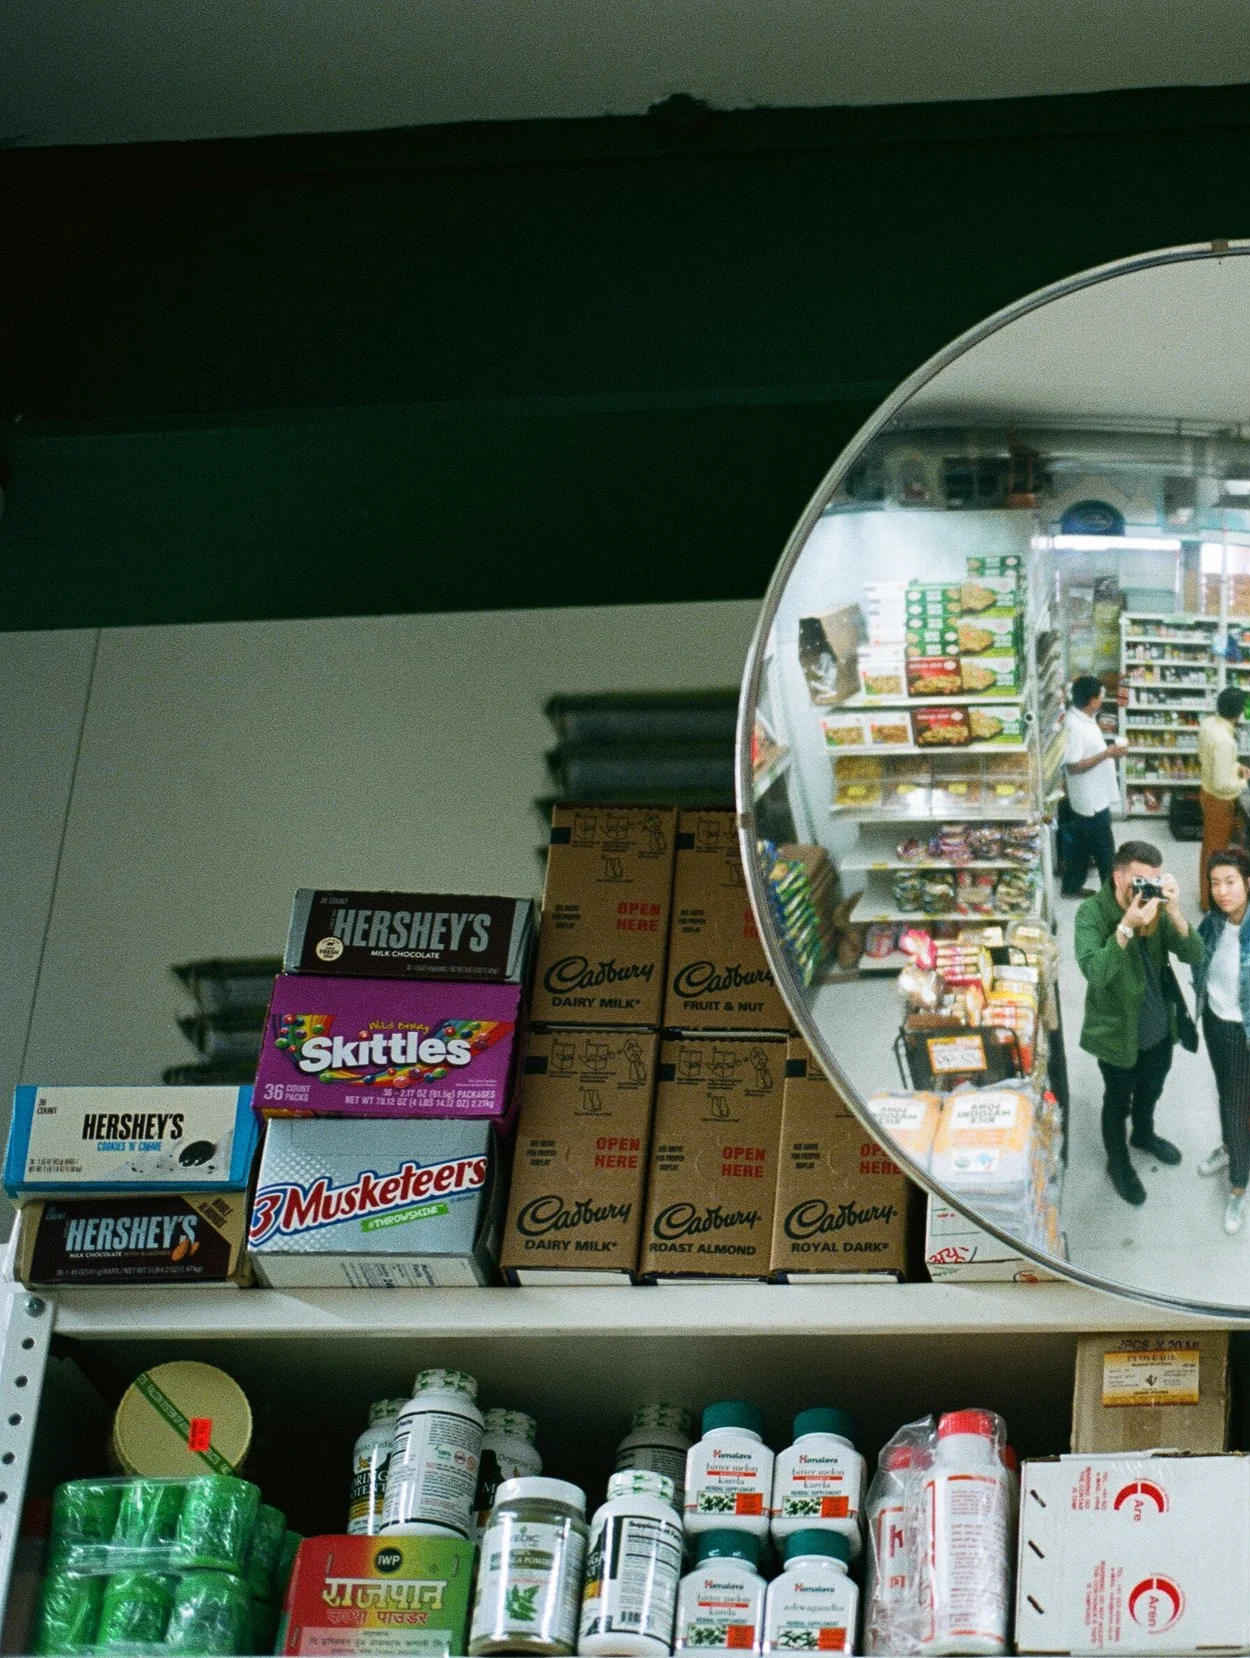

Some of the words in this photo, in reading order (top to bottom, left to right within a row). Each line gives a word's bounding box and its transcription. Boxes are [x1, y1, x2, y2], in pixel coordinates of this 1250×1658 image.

[616, 901, 661, 916] OPEN
[333, 909, 491, 952] HERSHEY'S
[616, 918, 658, 932] HERE
[392, 951, 440, 959] CHOCOLATE
[544, 955, 654, 995] Cadbury
[674, 961, 776, 998] Cadbury
[553, 997, 595, 1007] DAIRY
[684, 1001, 721, 1011] FRUIT
[724, 1001, 734, 1012] &
[738, 1002, 765, 1012] NUT
[299, 1031, 472, 1073] Skittles
[263, 1084, 284, 1100] 36
[286, 1085, 311, 1093] COUNT
[285, 1093, 309, 1101] PACKS
[457, 1091, 496, 1099] PACKAGES
[82, 1114, 185, 1140] HERSHEY'S
[596, 1137, 640, 1151] OPEN
[859, 1144, 887, 1157] OP
[721, 1146, 766, 1161] OPEN
[594, 1155, 638, 1168] HERE
[859, 1160, 902, 1175] HERE
[721, 1164, 763, 1178] HERE
[249, 1194, 282, 1238] 3
[282, 1158, 487, 1230] Musketeers
[517, 1195, 632, 1236] Cadbury
[653, 1202, 759, 1240] Cadbury
[784, 1199, 893, 1240] Cadbury
[65, 1215, 199, 1251] HERSHEY'S
[525, 1239, 571, 1250] DAIRY
[650, 1242, 693, 1253] ROAST
[697, 1244, 756, 1256] ALMOND
[791, 1242, 838, 1253] ROYAL
[1134, 1500, 1144, 1521] Are
[377, 1555, 400, 1566] IWP
[321, 1577, 448, 1610] राजपान
[377, 1610, 428, 1625] पाउडर
[1148, 1596, 1159, 1627] Aren
